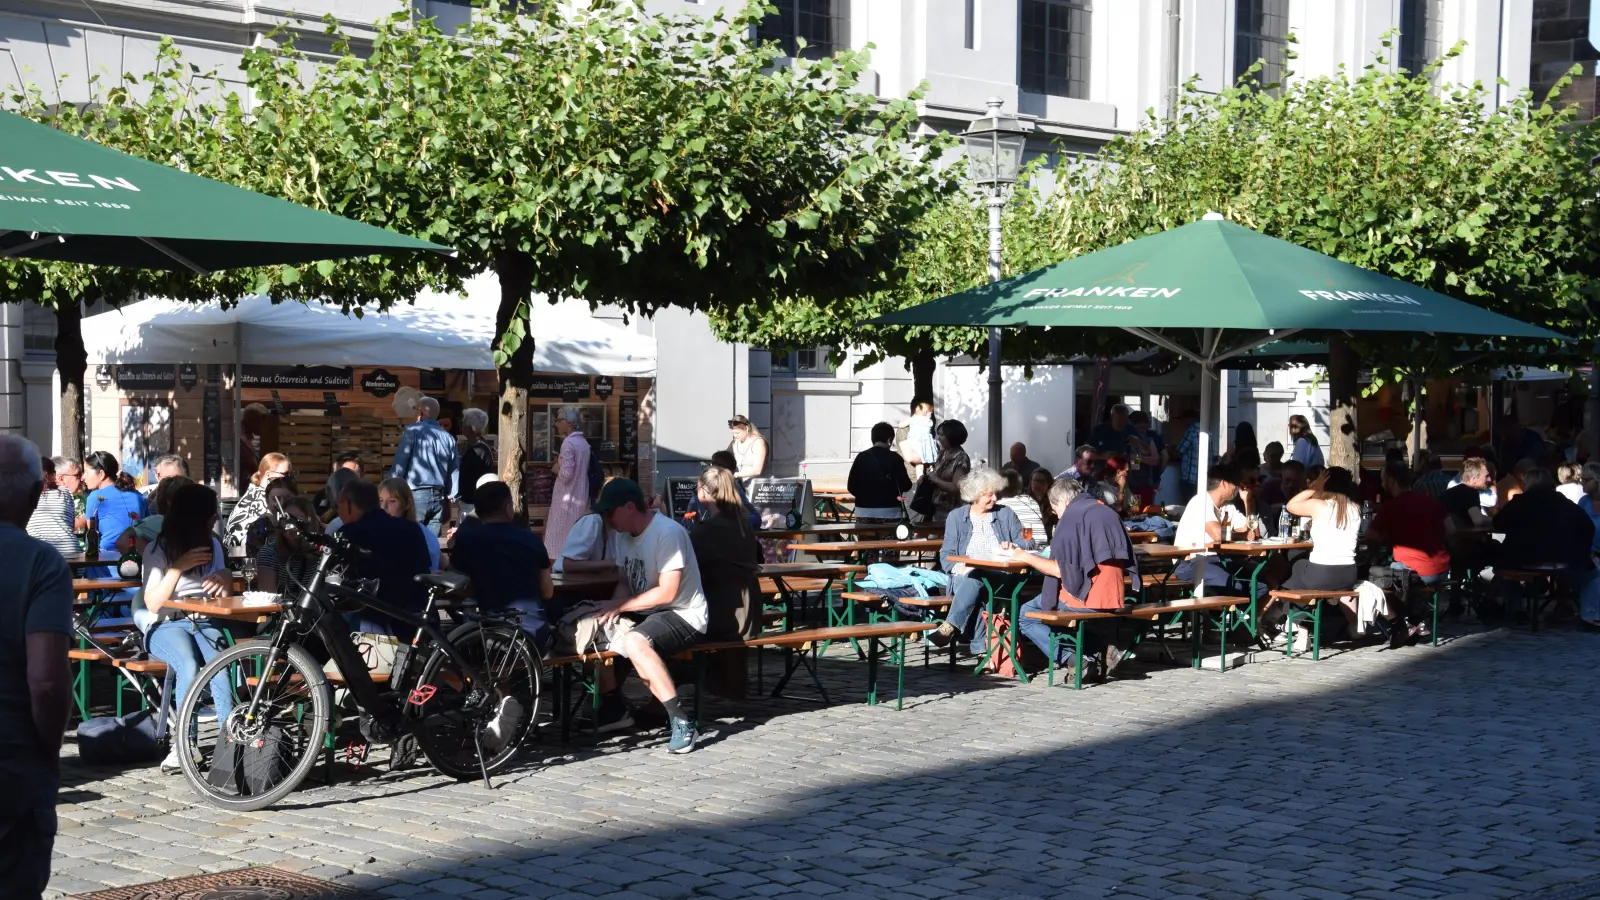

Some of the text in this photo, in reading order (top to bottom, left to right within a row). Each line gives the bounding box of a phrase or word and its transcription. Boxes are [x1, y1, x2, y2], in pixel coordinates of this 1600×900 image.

[0, 166, 141, 191] KEN
[54, 198, 89, 206] SEIT
[1023, 286, 1182, 299] FRANKEN
[274, 373, 308, 384] Österreich
[310, 376, 323, 384] und
[325, 376, 350, 385] Südtirol
